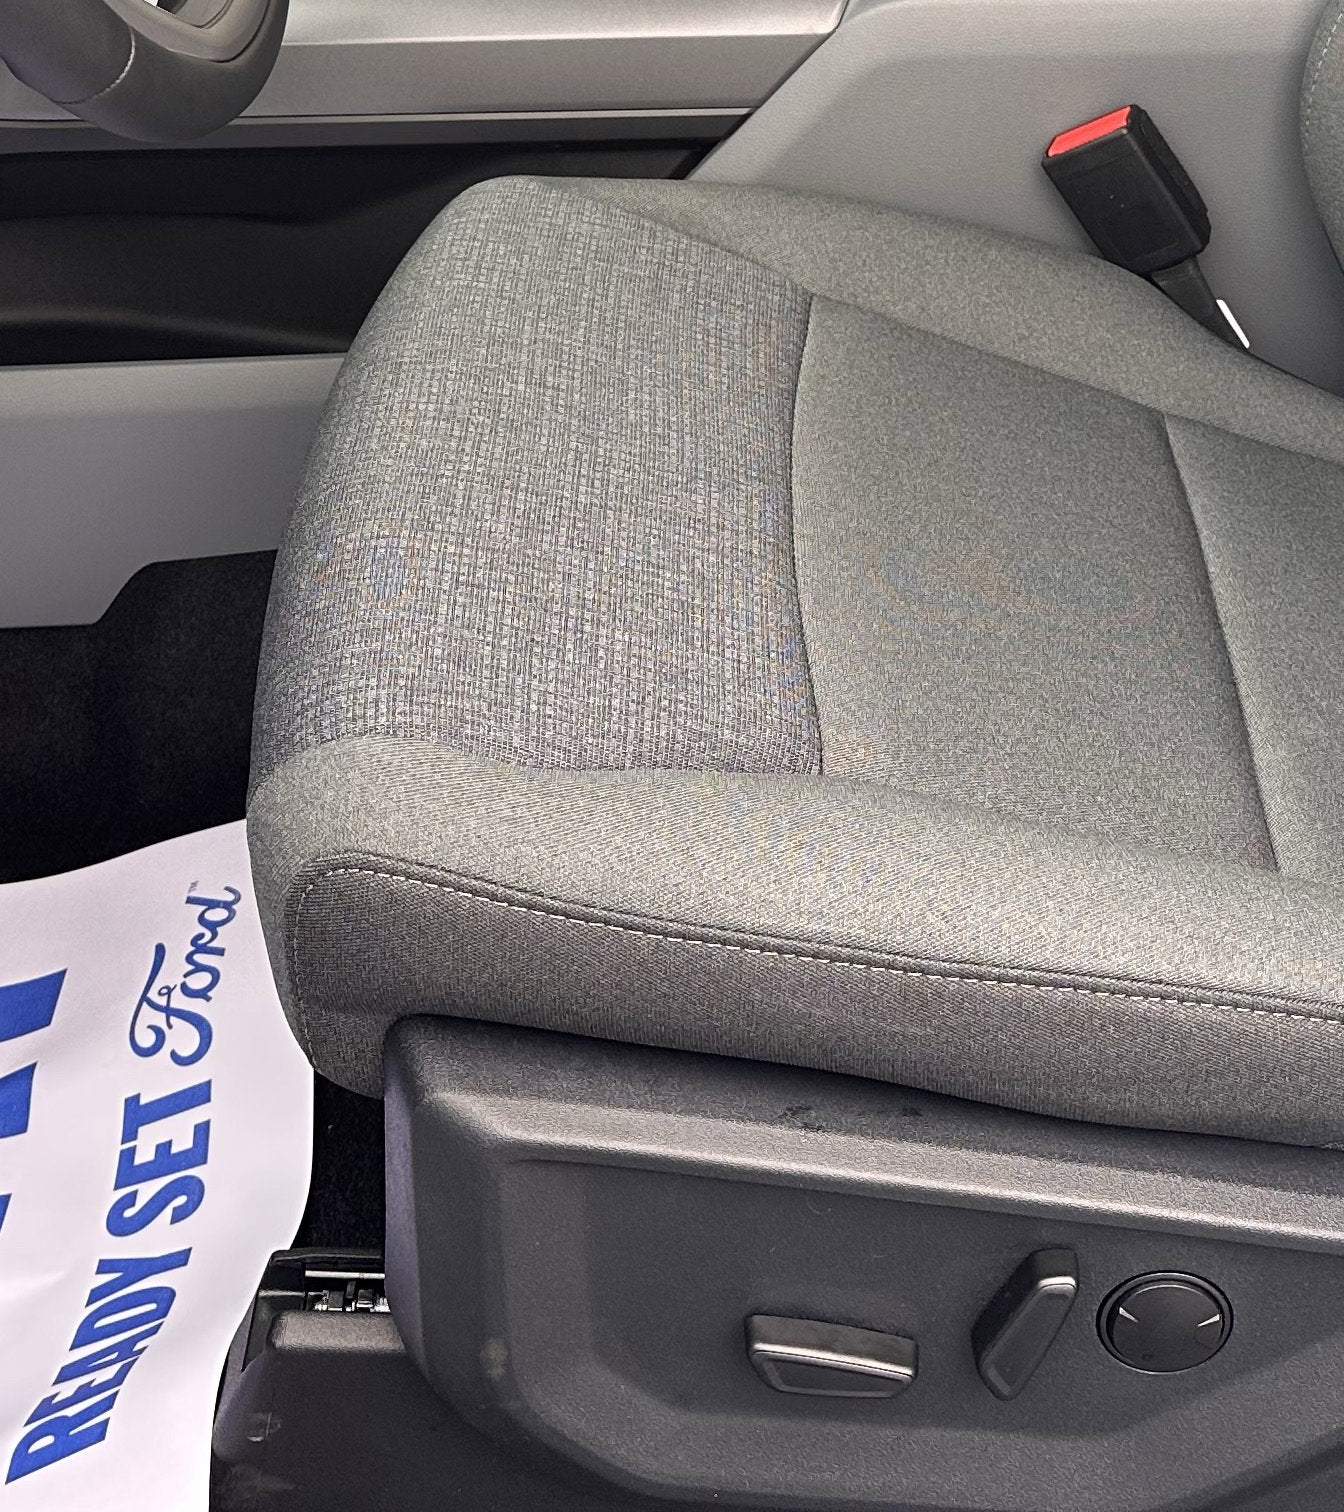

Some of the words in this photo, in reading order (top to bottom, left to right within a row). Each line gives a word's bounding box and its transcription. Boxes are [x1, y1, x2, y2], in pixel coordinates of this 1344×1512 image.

[129, 885, 242, 1067] Ford
[105, 1079, 212, 1239] SET
[5, 1247, 192, 1484] READY
